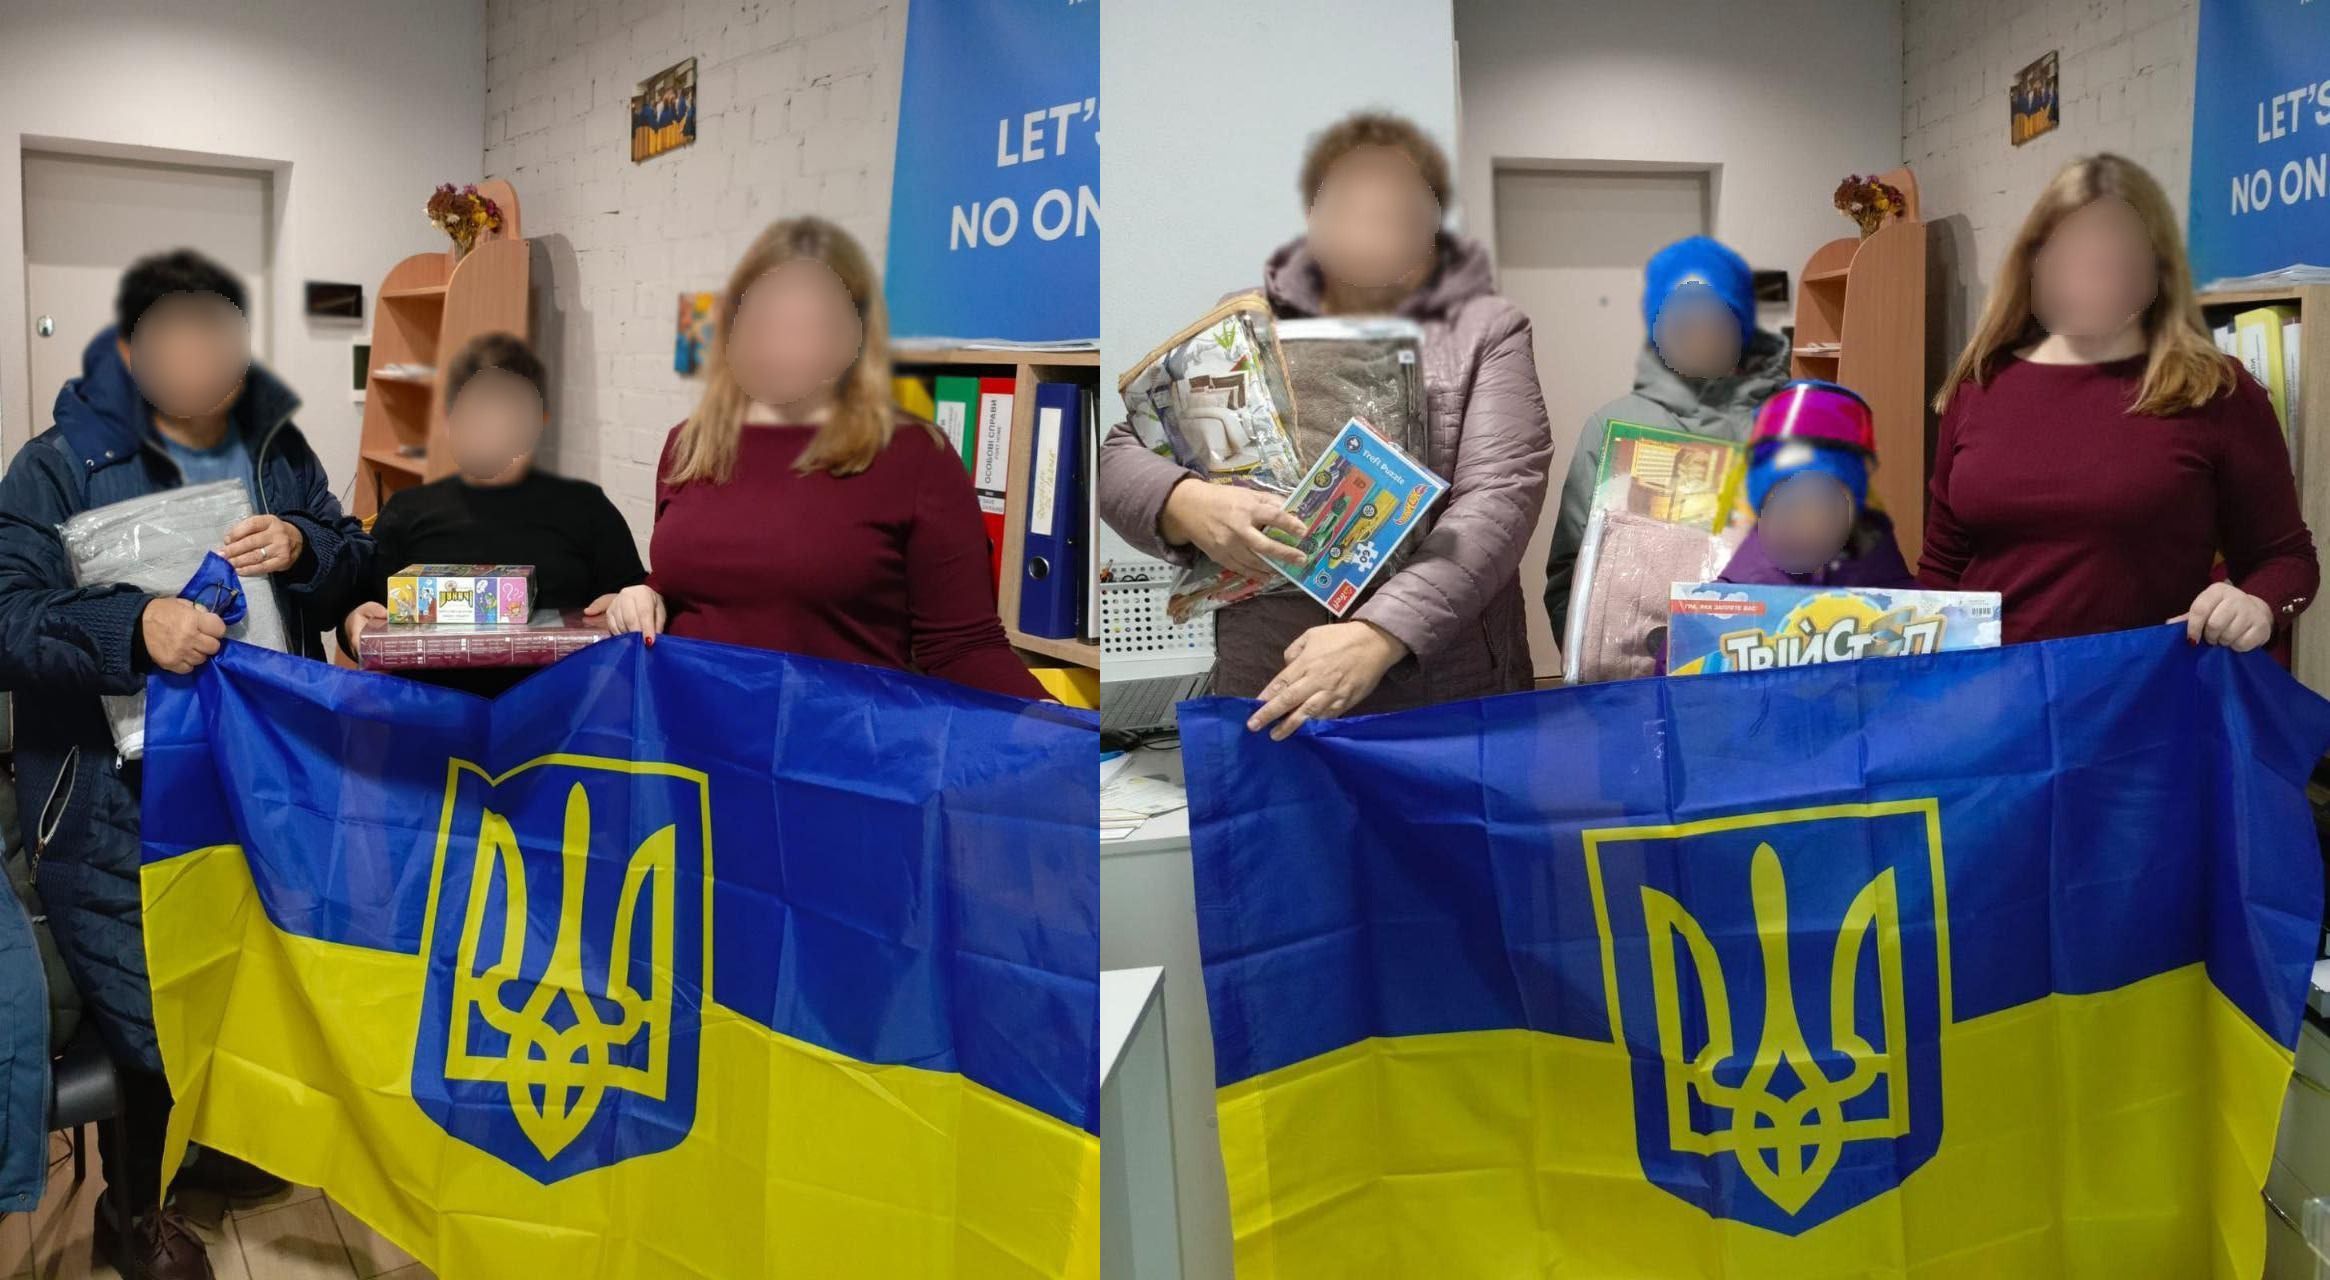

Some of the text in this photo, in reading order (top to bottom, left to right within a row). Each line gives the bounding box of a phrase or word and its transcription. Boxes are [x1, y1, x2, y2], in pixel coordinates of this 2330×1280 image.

[997, 97, 1100, 168] LET'
[2231, 153, 2330, 216] NO ON
[950, 197, 1019, 250] NO
[984, 400, 998, 484] ОСОБОВІ СПРАВИ
[1362, 450, 1405, 485] Trefl Puzzle
